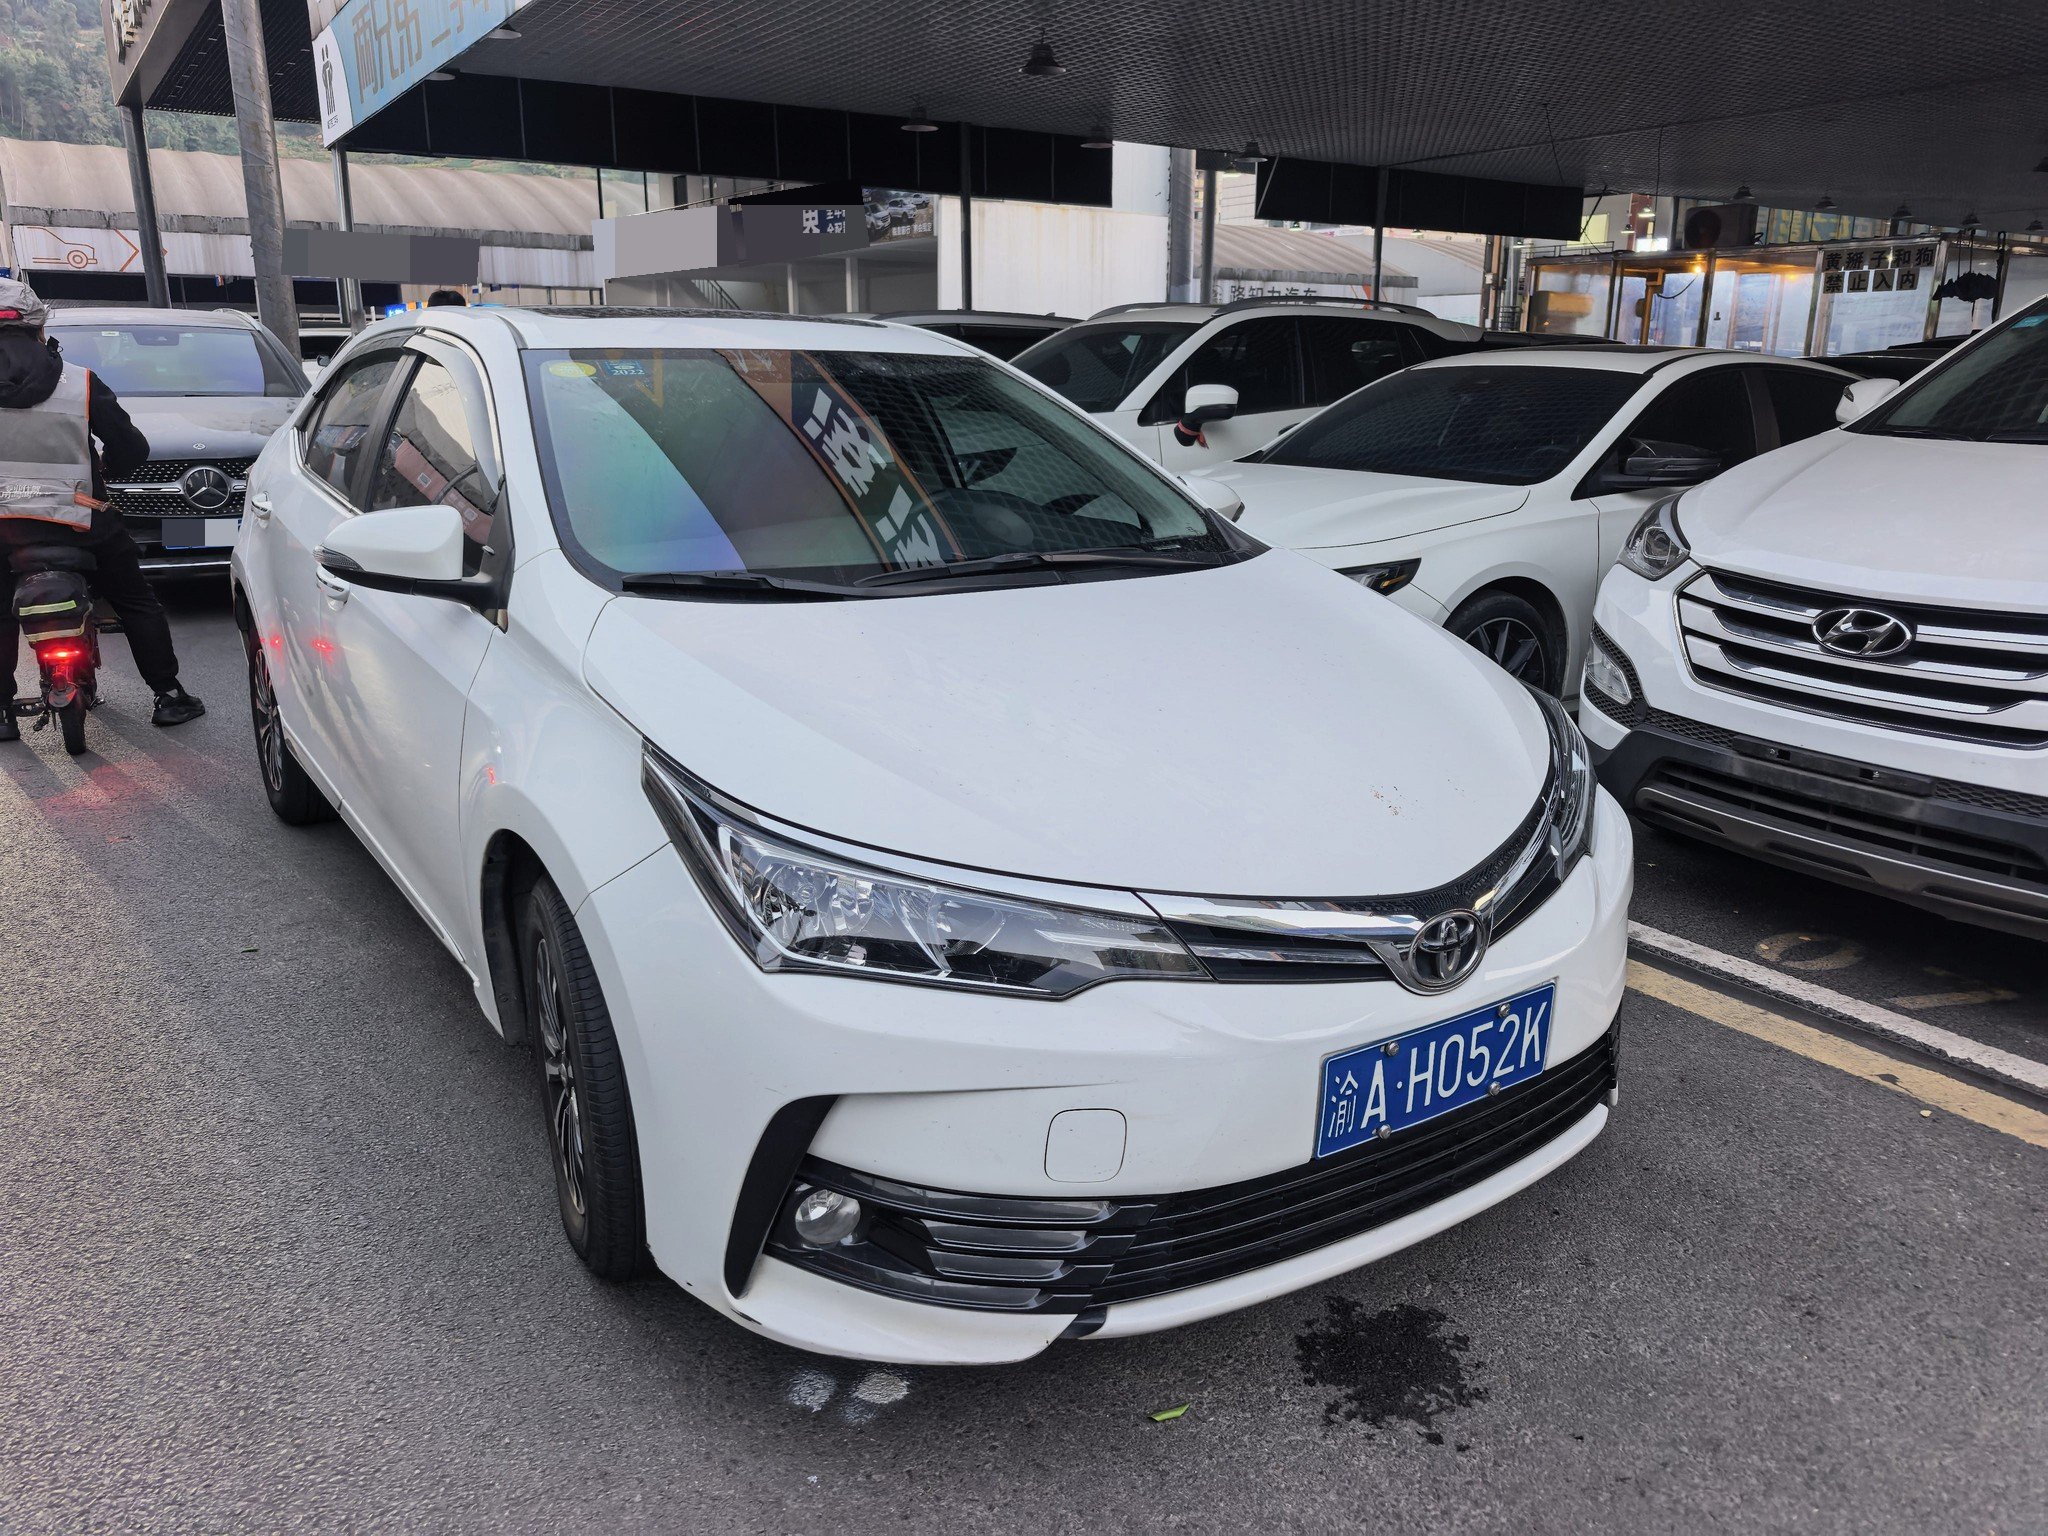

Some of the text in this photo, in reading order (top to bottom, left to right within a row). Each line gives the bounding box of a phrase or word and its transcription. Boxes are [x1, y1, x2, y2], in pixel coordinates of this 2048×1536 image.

[1825, 270, 1916, 292] 禁止入内
[1327, 1001, 1548, 1138] 渝A·H052K
